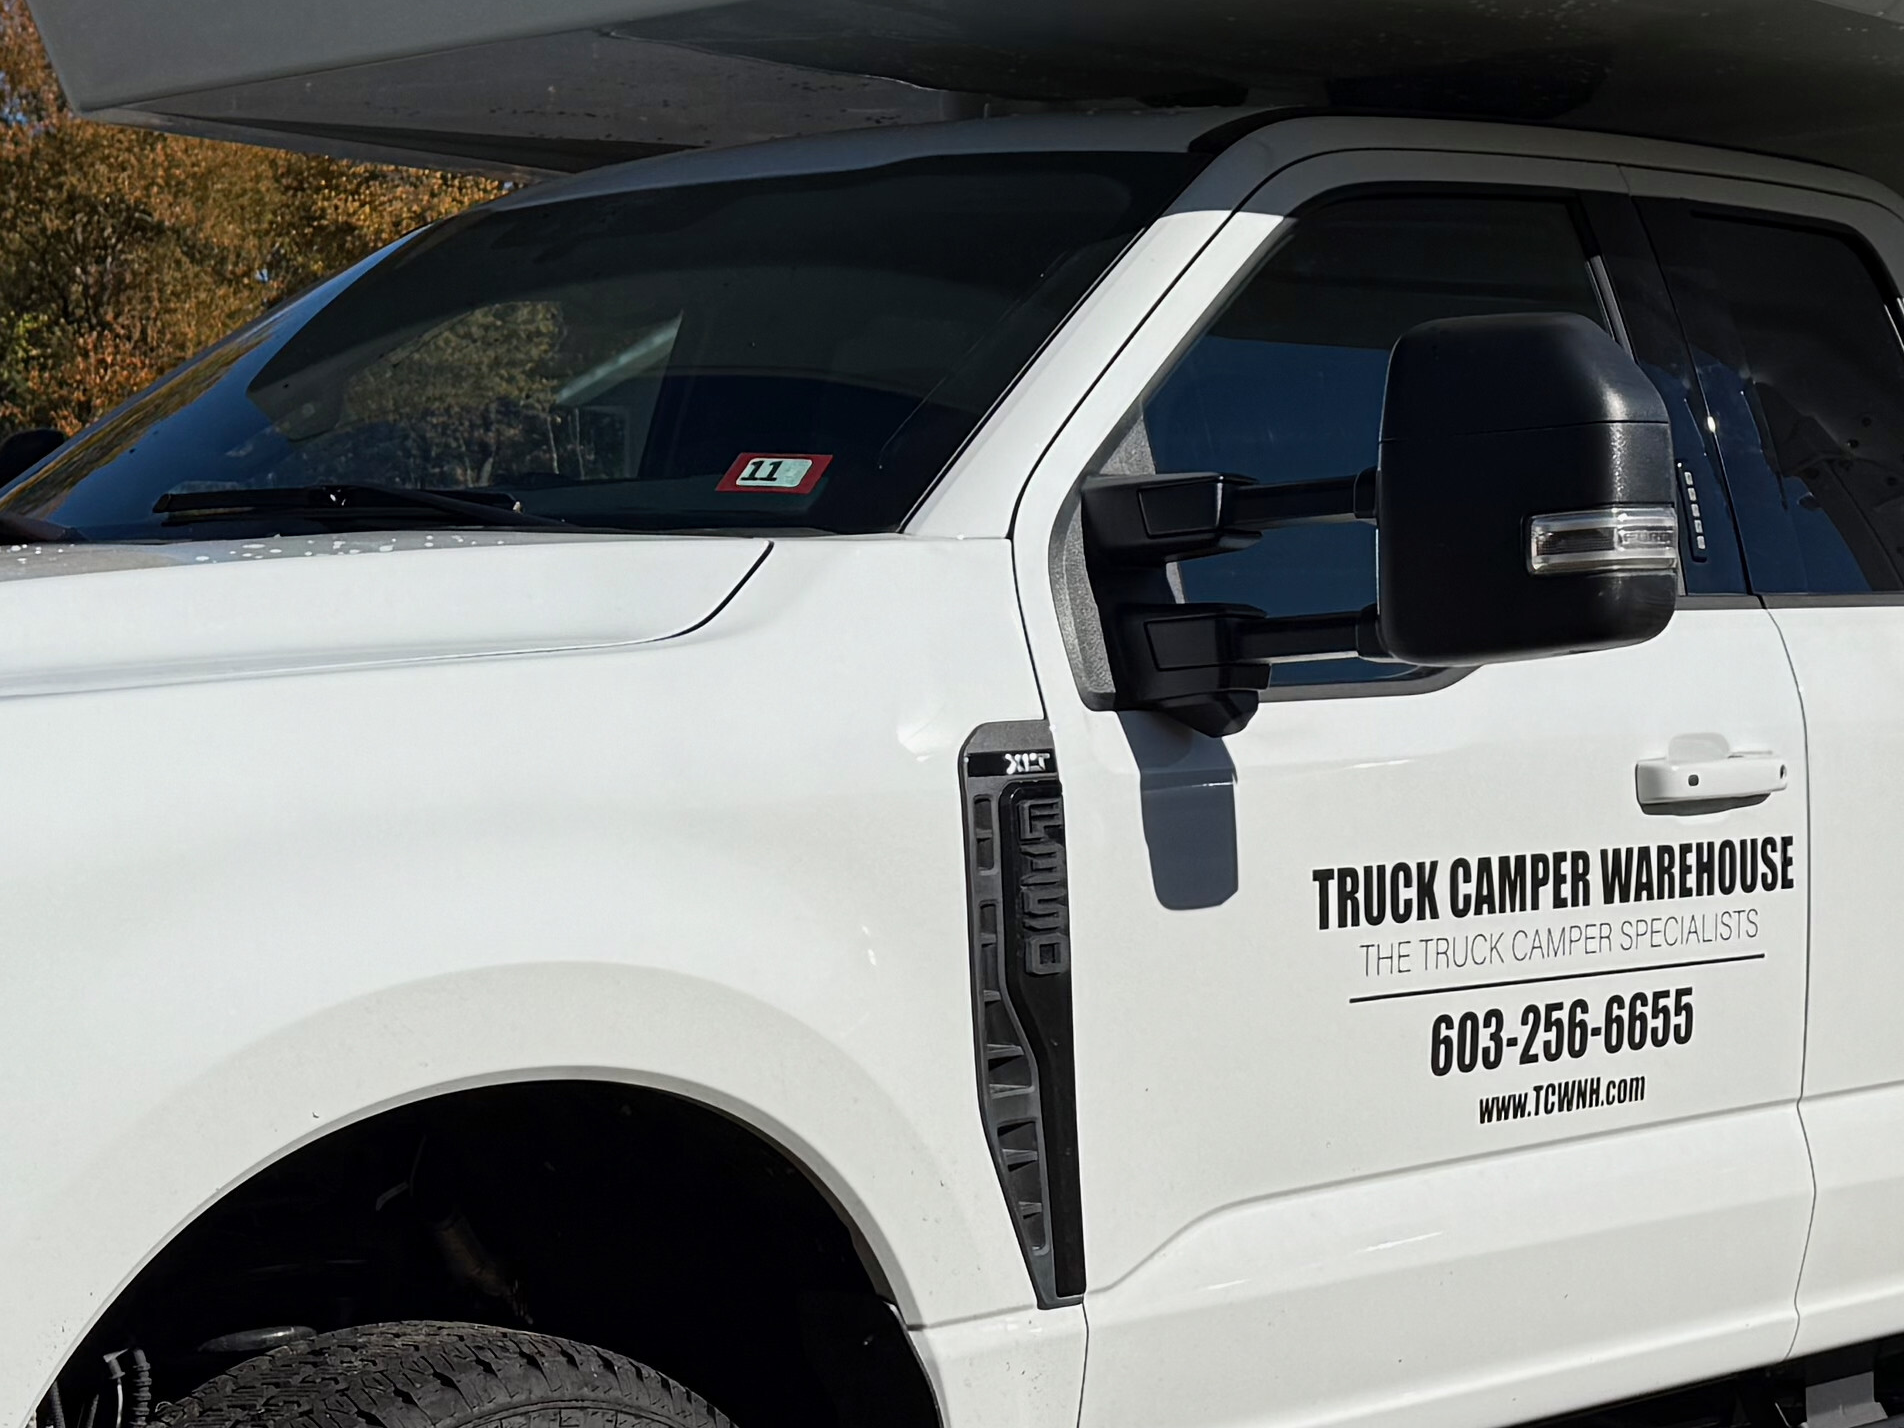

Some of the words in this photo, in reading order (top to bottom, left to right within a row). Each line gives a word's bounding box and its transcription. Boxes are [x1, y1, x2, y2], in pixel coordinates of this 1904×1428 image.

[740, 459, 784, 482] 11
[1312, 859, 1440, 931] TRUCK
[1449, 850, 1591, 919] CAMPER
[1599, 835, 1795, 905] WAREHOUSE
[1359, 940, 1412, 977] THE
[1418, 932, 1505, 971] TRUCK
[1511, 923, 1613, 962] CAMPER
[1620, 908, 1759, 951] SPECIALISTS
[1430, 986, 1694, 1077] 603-256-6655
[1479, 1075, 1646, 1125] www.TCWNH.com
